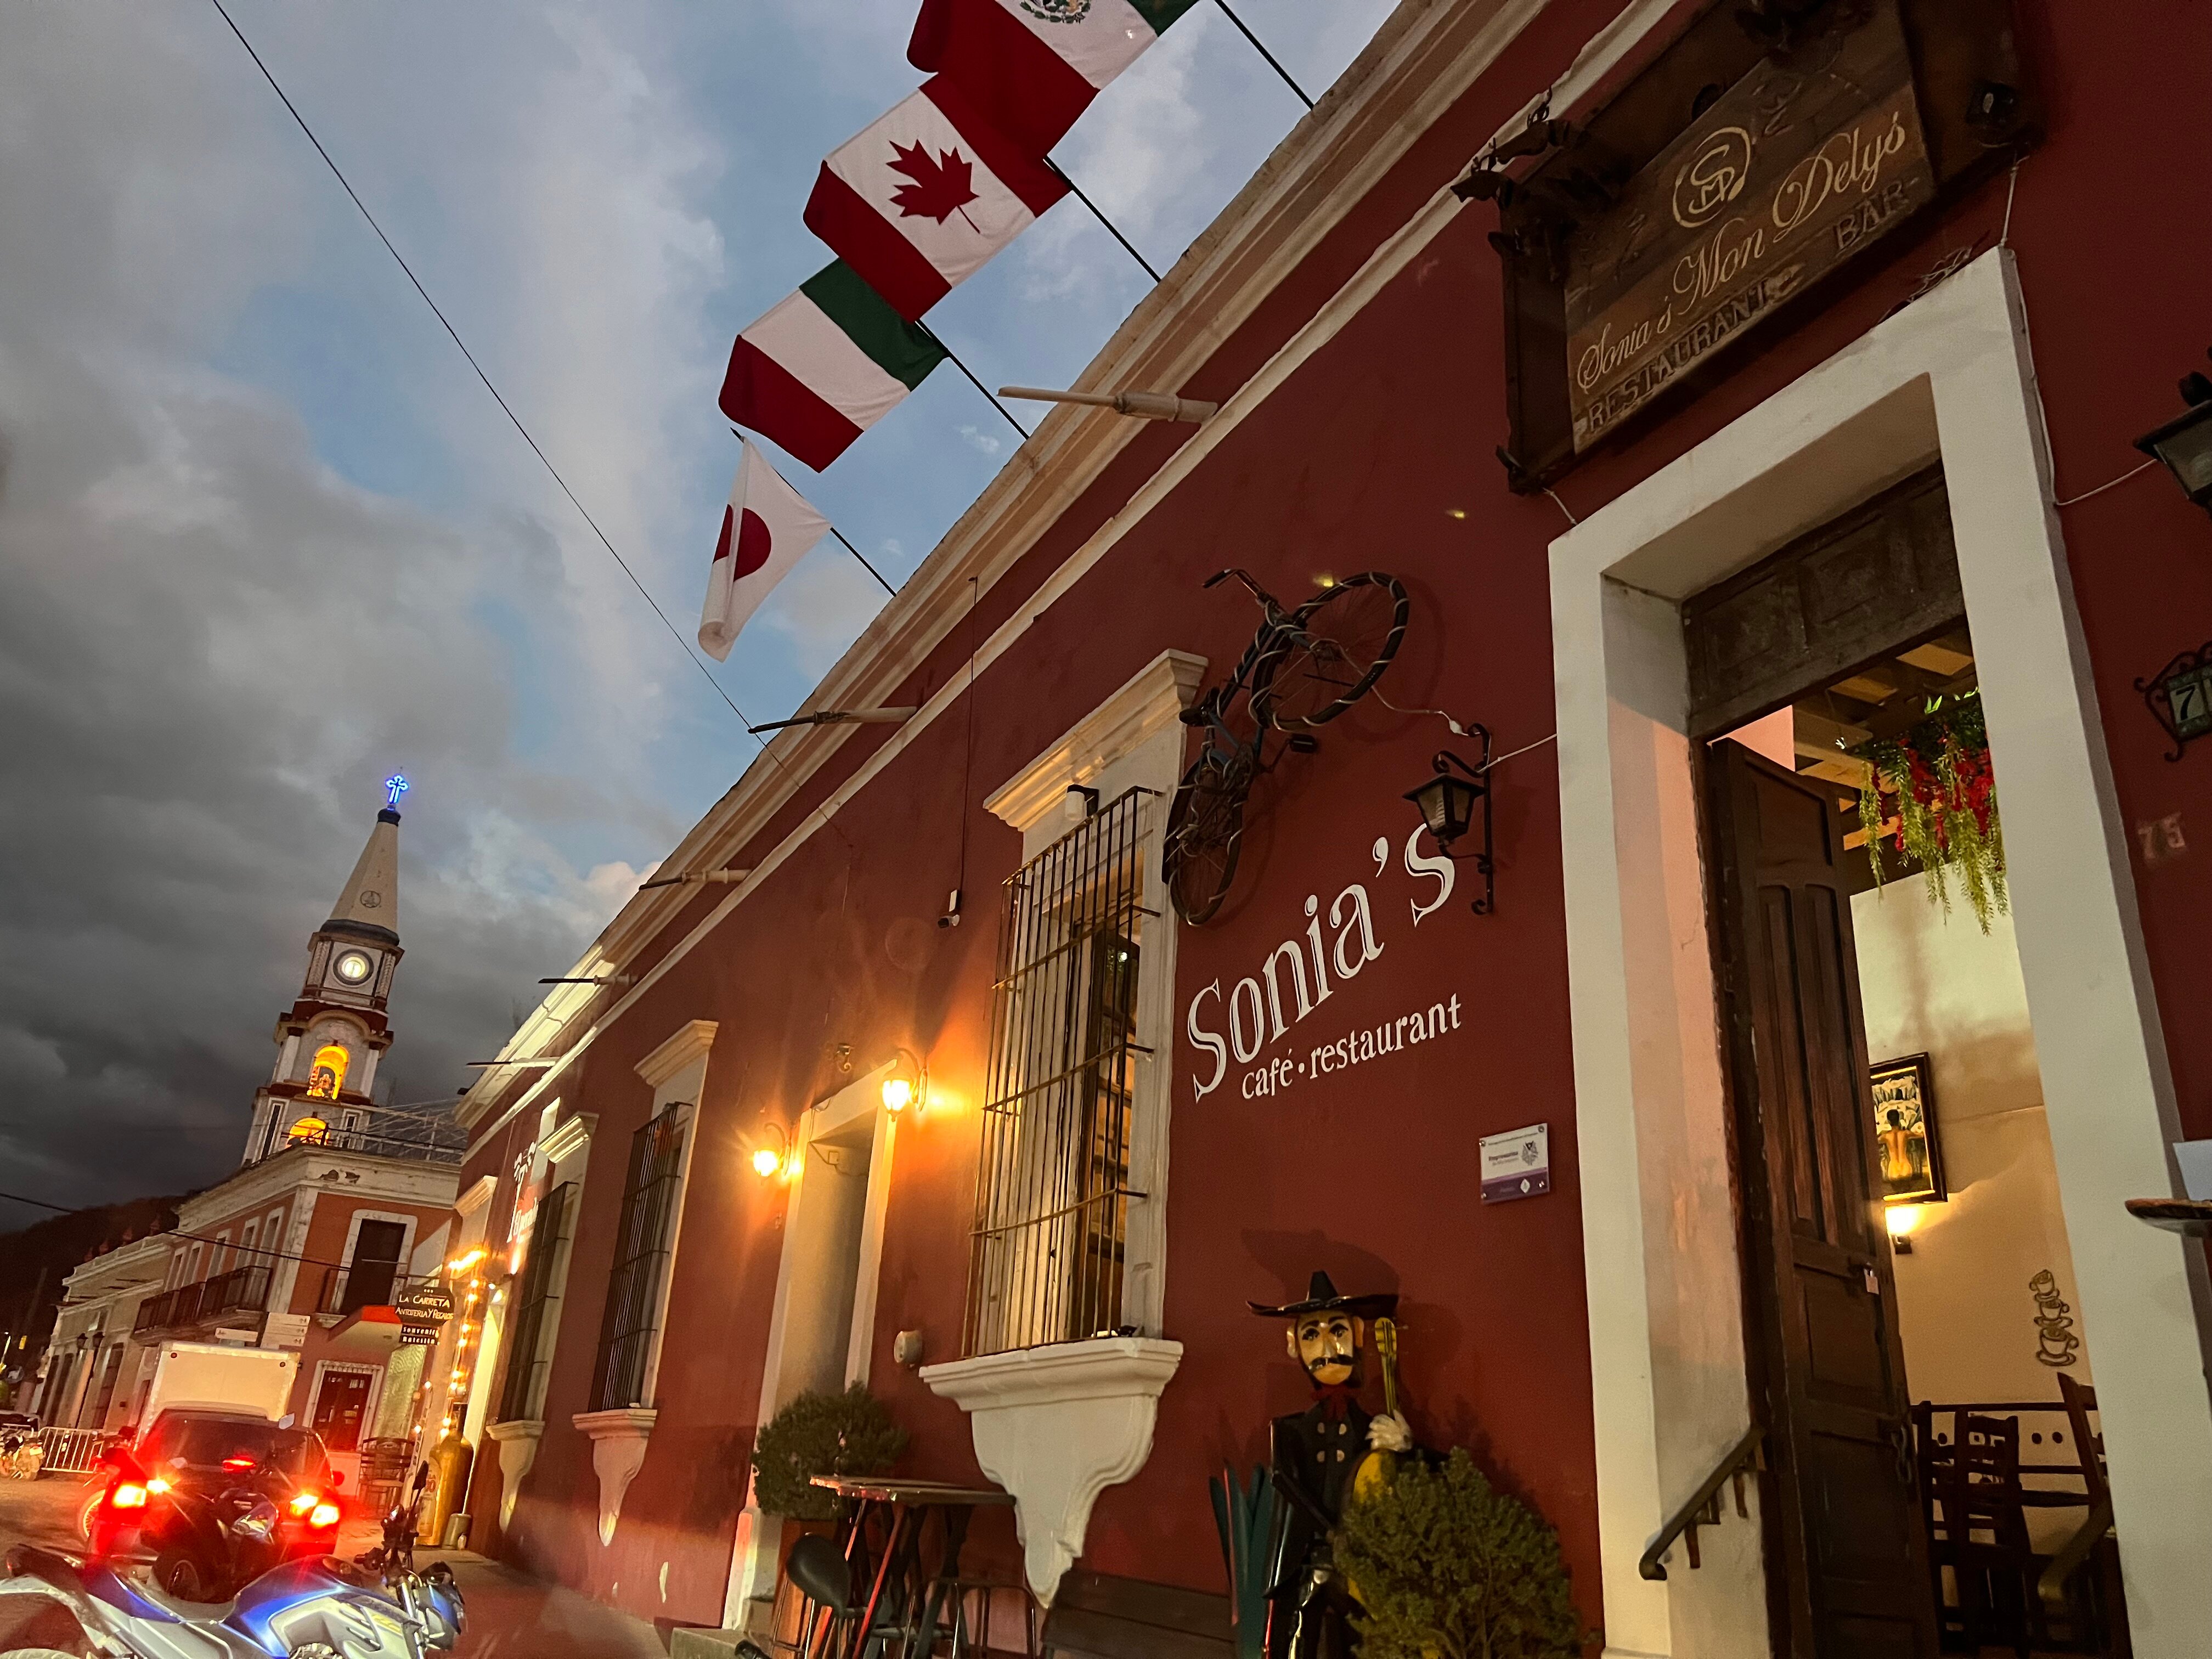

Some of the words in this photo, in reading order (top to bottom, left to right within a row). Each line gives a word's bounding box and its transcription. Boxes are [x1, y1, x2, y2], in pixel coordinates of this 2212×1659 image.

[1588, 277, 1768, 432] RESTAURANT
[1835, 180, 1909, 251] BAR
[1673, 217, 1765, 315] Mon
[1187, 823, 1455, 1103] Sonia's
[1242, 1048, 1292, 1099] café
[1310, 993, 1462, 1079] restaurant
[399, 1294, 409, 1303] LA
[413, 1295, 450, 1308] CARRETA
